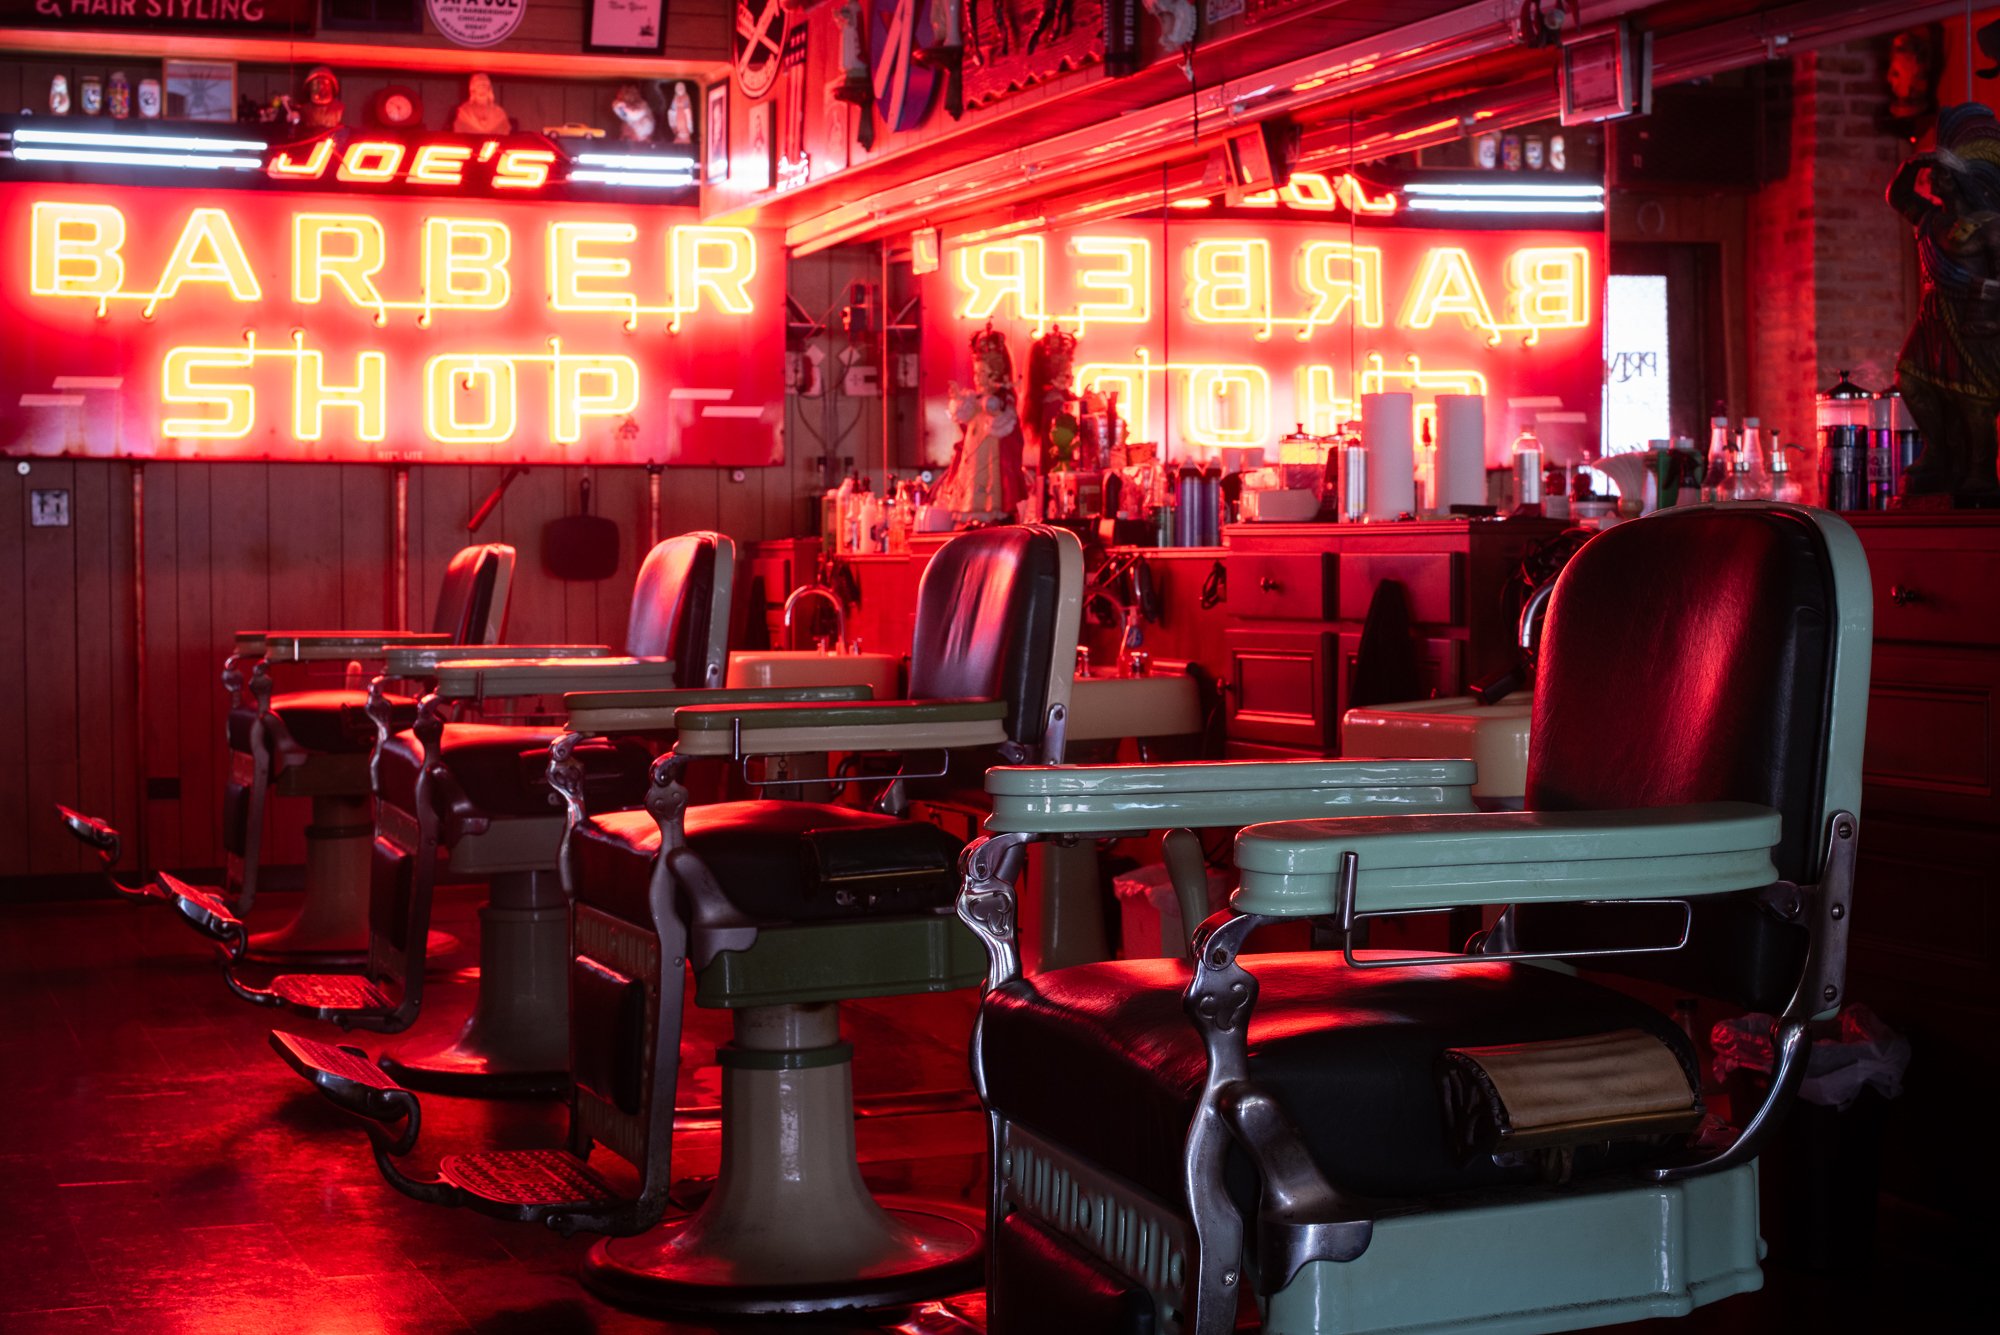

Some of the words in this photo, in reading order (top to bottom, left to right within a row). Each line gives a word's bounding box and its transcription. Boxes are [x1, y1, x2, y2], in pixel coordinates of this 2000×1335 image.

[71, 0, 136, 16] HAIR
[146, 0, 265, 21] STYLING
[267, 136, 558, 190] JOE'S
[30, 201, 758, 318] BARBER
[160, 346, 641, 443] SHOP
